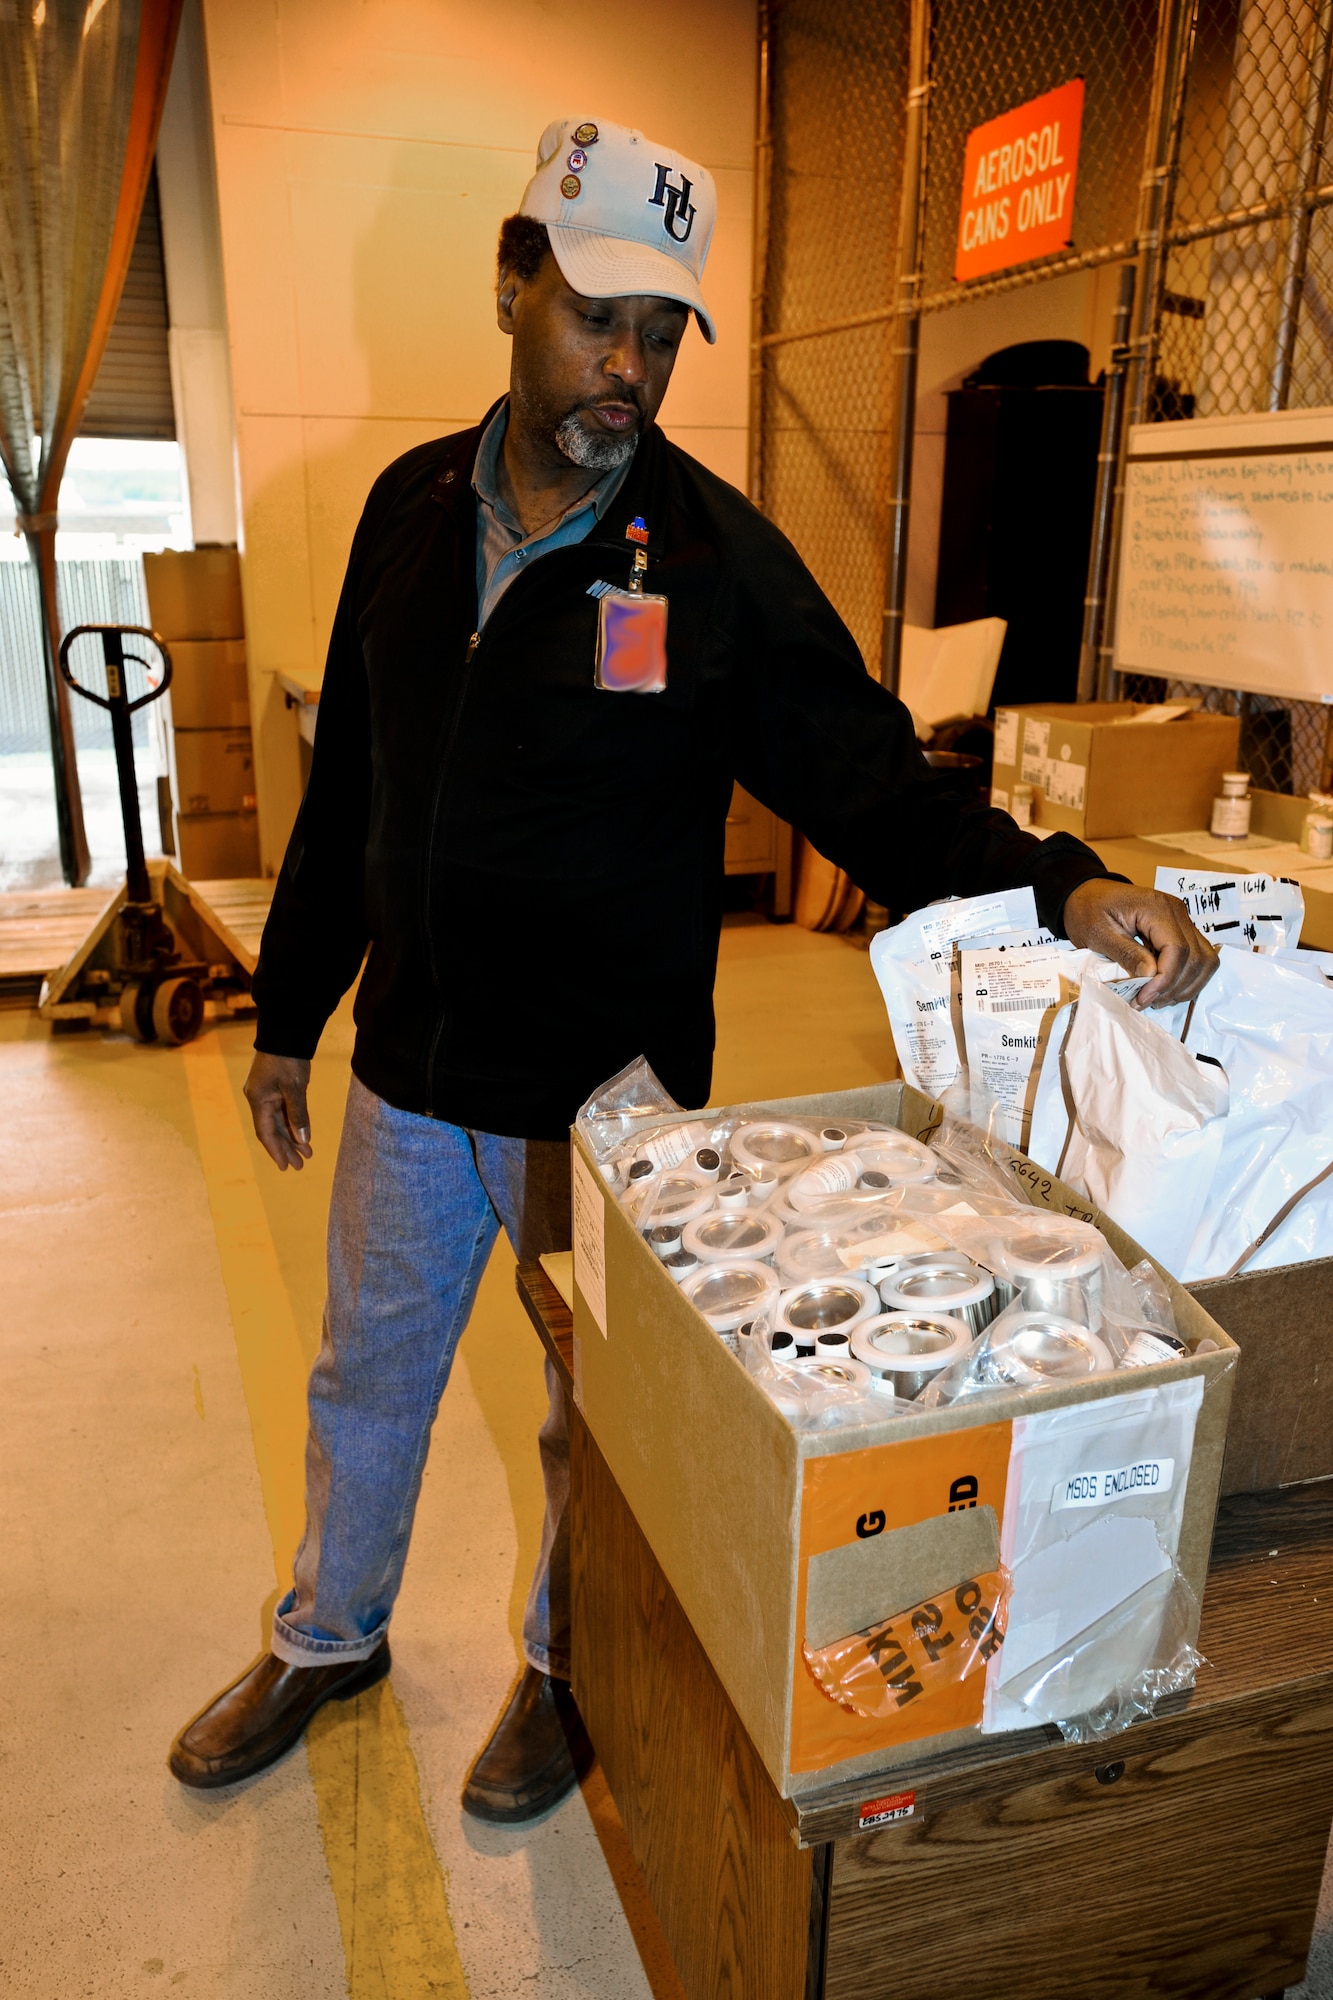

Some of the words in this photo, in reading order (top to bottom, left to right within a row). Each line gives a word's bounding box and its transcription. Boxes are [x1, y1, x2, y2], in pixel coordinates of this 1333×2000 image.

[973, 121, 1064, 199] AEROSOL
[646, 161, 698, 244] HU
[962, 196, 1011, 252] CANS
[1017, 172, 1071, 233] ONLY
[930, 951, 942, 961] B
[975, 988, 988, 996] B
[1066, 1476, 1097, 1500] MSDS
[1104, 1464, 1160, 1496] ENCLOSED
